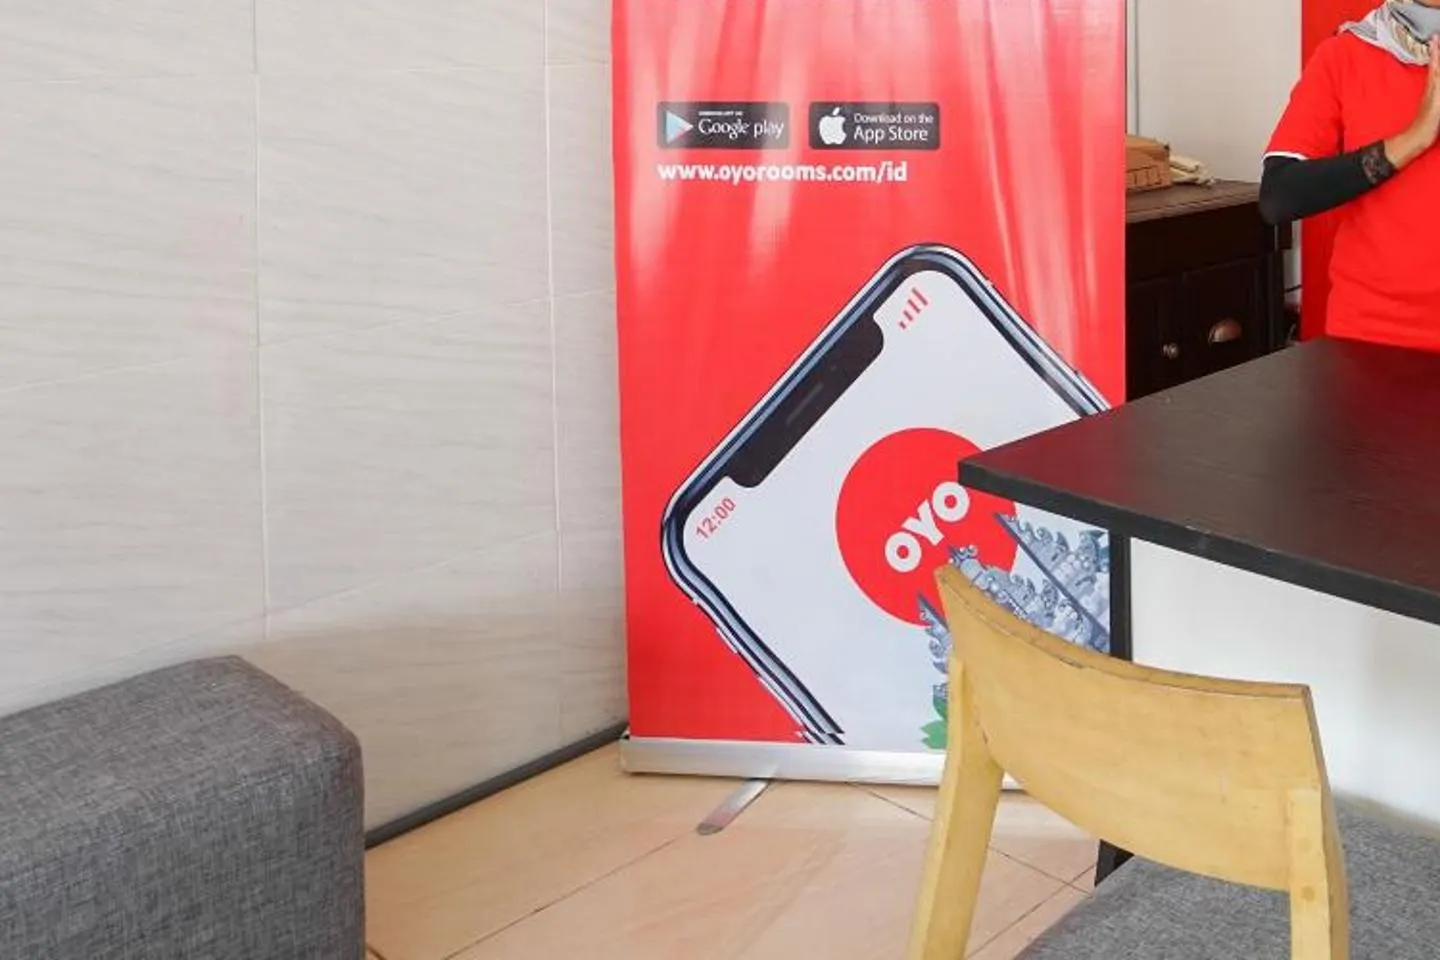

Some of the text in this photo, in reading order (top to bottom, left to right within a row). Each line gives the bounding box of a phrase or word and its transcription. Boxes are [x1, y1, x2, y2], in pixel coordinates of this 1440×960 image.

[698, 118, 785, 140] Google play
[853, 125, 929, 144] App Store
[657, 160, 908, 184] www.oyorooms.com/id
[695, 496, 736, 541] 12:00
[884, 481, 971, 573] OYO
